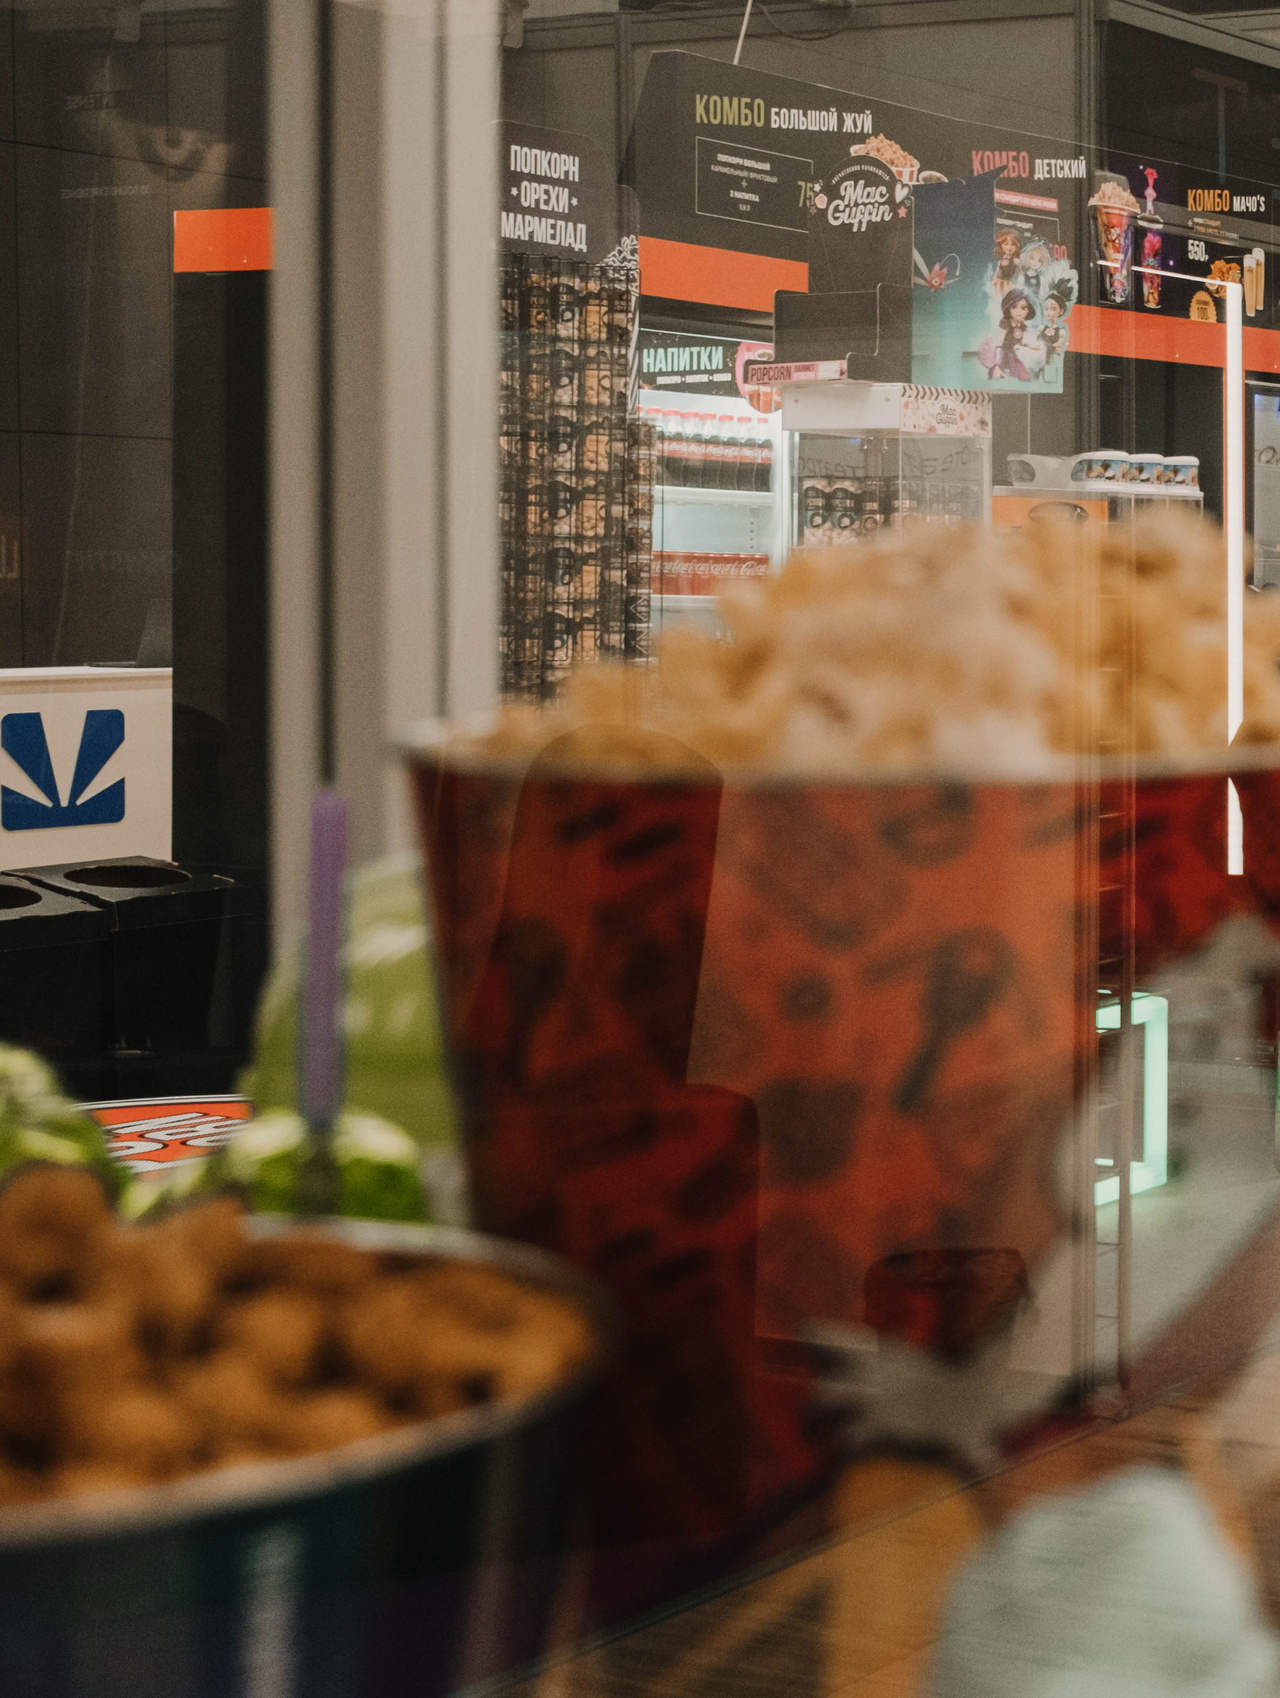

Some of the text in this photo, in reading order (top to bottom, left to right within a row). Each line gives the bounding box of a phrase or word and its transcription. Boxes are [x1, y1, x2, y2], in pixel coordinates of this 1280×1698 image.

[696, 94, 873, 134] КОМБО БОЛЬШОЙ ЖУЙ
[510, 144, 580, 182] ПОПКОРН
[972, 150, 1086, 180] КОМБО ДЕТСКИЙ
[520, 180, 569, 213] ОРЕХИ
[797, 181, 815, 208] 75
[840, 180, 889, 207] Mac
[1187, 189, 1265, 212] КОМБО МАЧО'S
[828, 199, 893, 231] Guffin
[501, 211, 587, 253] МАРМЕЛАД
[643, 346, 723, 373] НАПИТКИ
[750, 365, 792, 383] POPCORN
